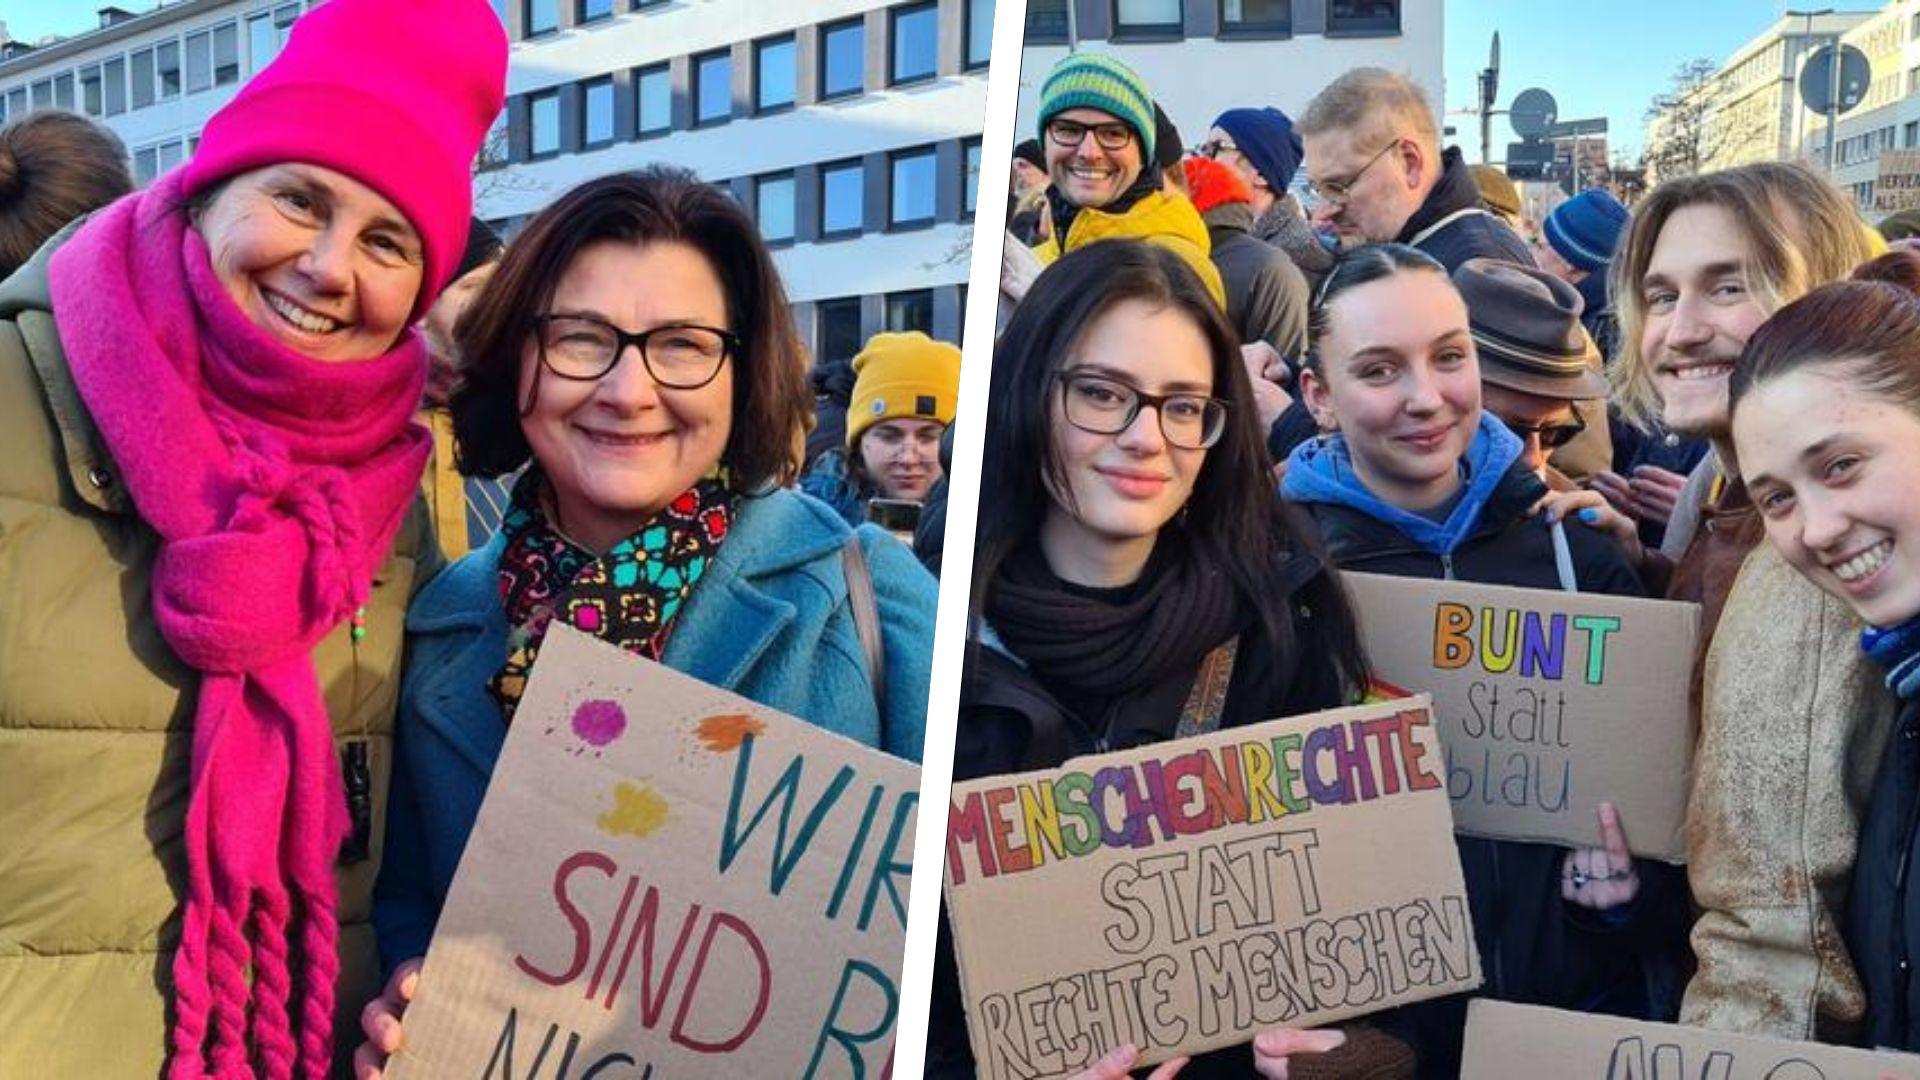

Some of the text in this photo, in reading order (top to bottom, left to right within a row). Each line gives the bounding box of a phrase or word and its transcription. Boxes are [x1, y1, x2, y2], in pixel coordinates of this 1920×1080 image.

[1433, 602, 1621, 685] BUNT
[719, 732, 919, 931] WIR
[947, 711, 1442, 885] MENSCHENRECHTE
[1449, 746, 1570, 812] blau
[514, 851, 771, 1053] SIND
[1101, 829, 1320, 954] STATT
[979, 896, 1472, 1080] RECHTE MENSCHEN
